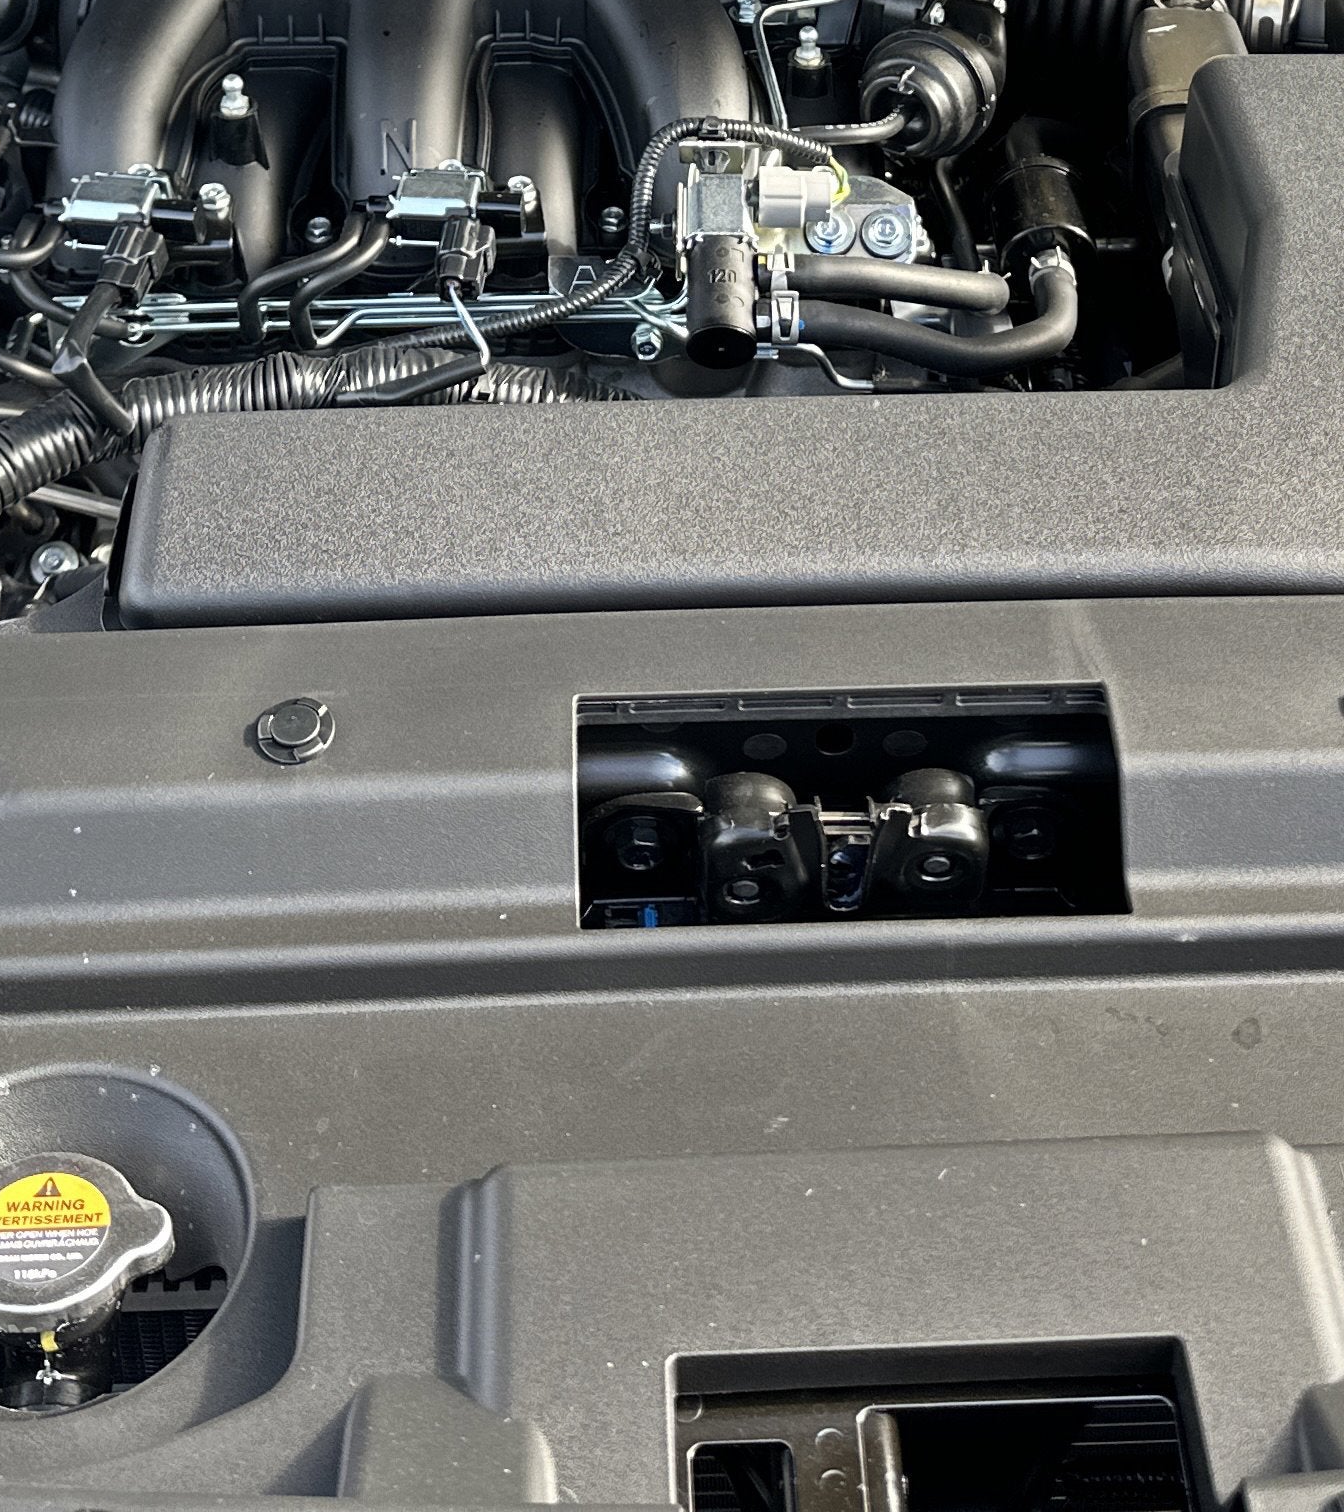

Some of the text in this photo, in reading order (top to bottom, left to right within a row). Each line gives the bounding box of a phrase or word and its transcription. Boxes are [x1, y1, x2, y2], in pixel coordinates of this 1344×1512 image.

[6, 1198, 85, 1213] WARNING
[16, 1230, 43, 1239] OPEN
[44, 1229, 75, 1239] WHEN
